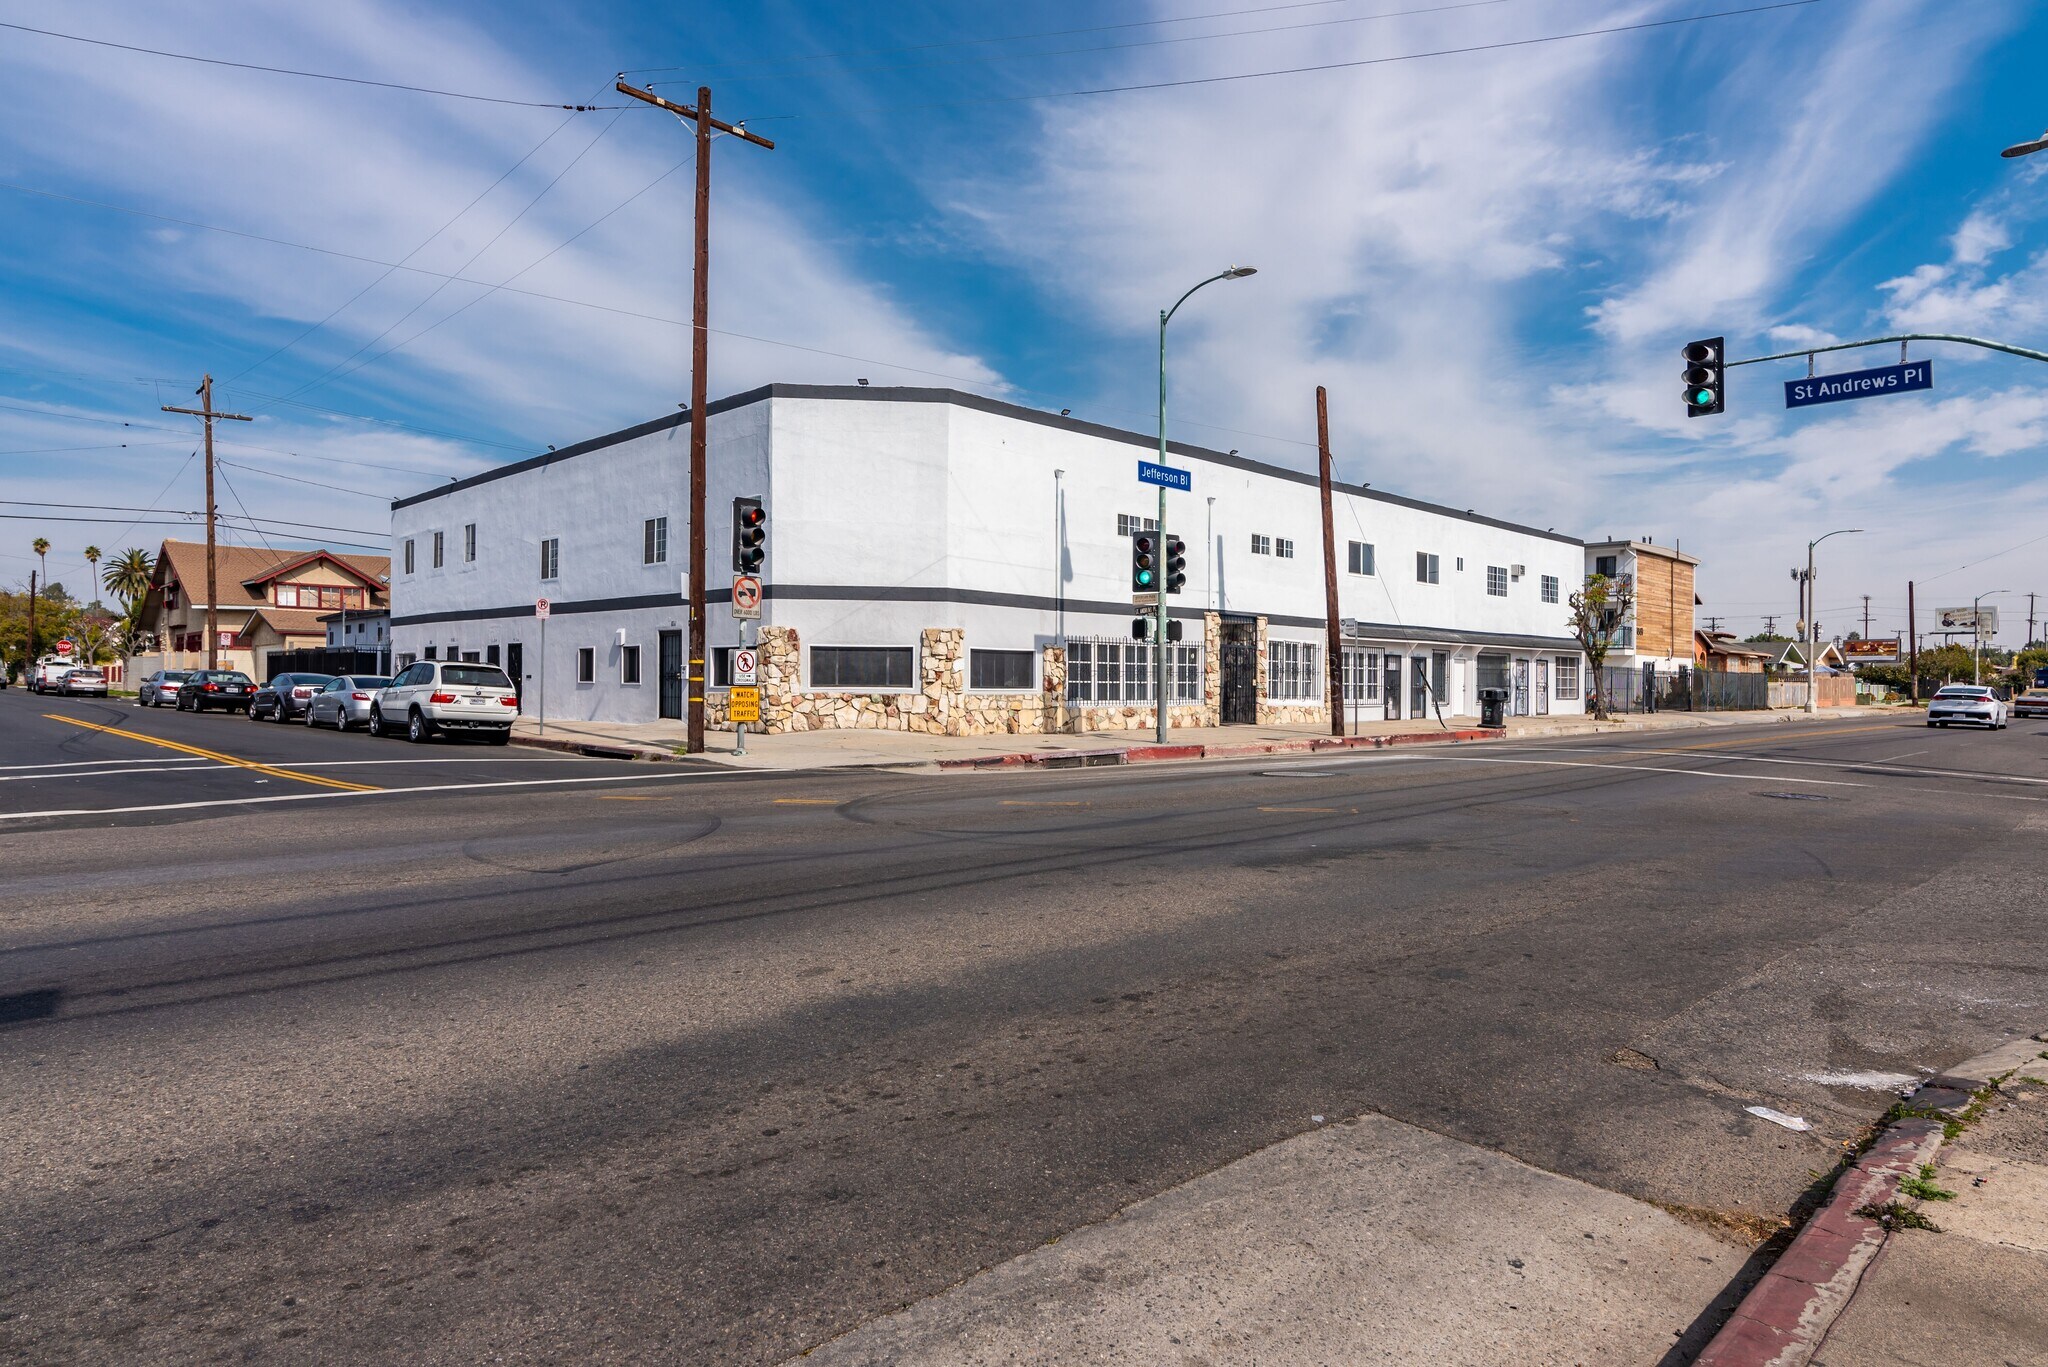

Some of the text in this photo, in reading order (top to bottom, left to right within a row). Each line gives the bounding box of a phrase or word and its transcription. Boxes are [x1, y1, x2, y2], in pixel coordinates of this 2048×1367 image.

[1794, 367, 1923, 400] St Andrews Pl
[1141, 466, 1188, 486] Jefferson Bl
[736, 691, 755, 699] WATCH
[731, 700, 759, 708] OPPOSING
[733, 710, 756, 718] TRAFFIC
